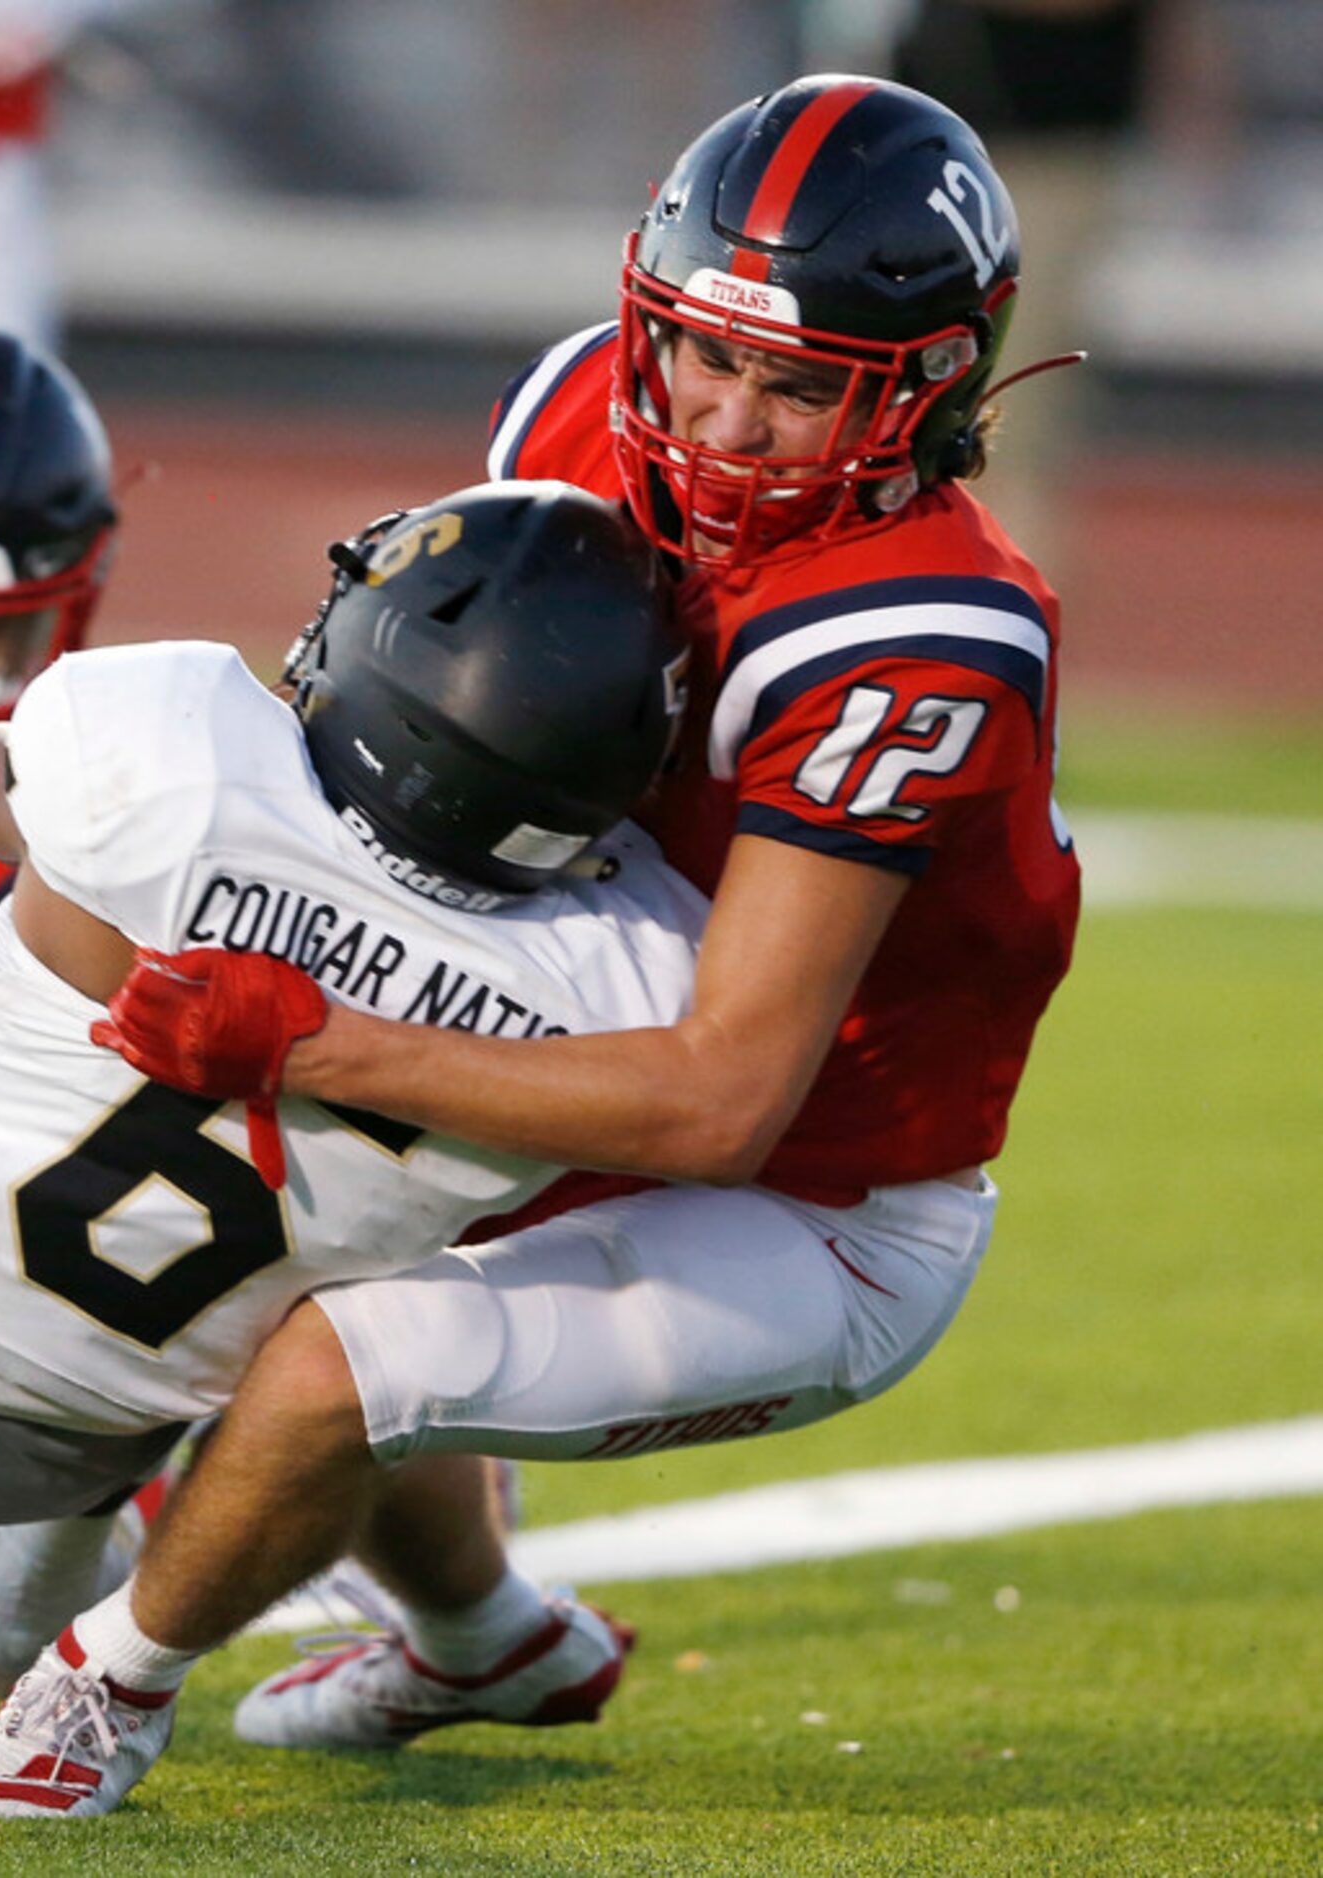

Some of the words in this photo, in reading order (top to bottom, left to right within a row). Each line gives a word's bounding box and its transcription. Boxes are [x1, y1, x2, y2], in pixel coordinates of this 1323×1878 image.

[927, 157, 1010, 289] 12
[710, 279, 772, 312] TITANS
[791, 683, 987, 822] 12
[186, 876, 408, 1006] COUGAR
[402, 961, 570, 1040] NAT
